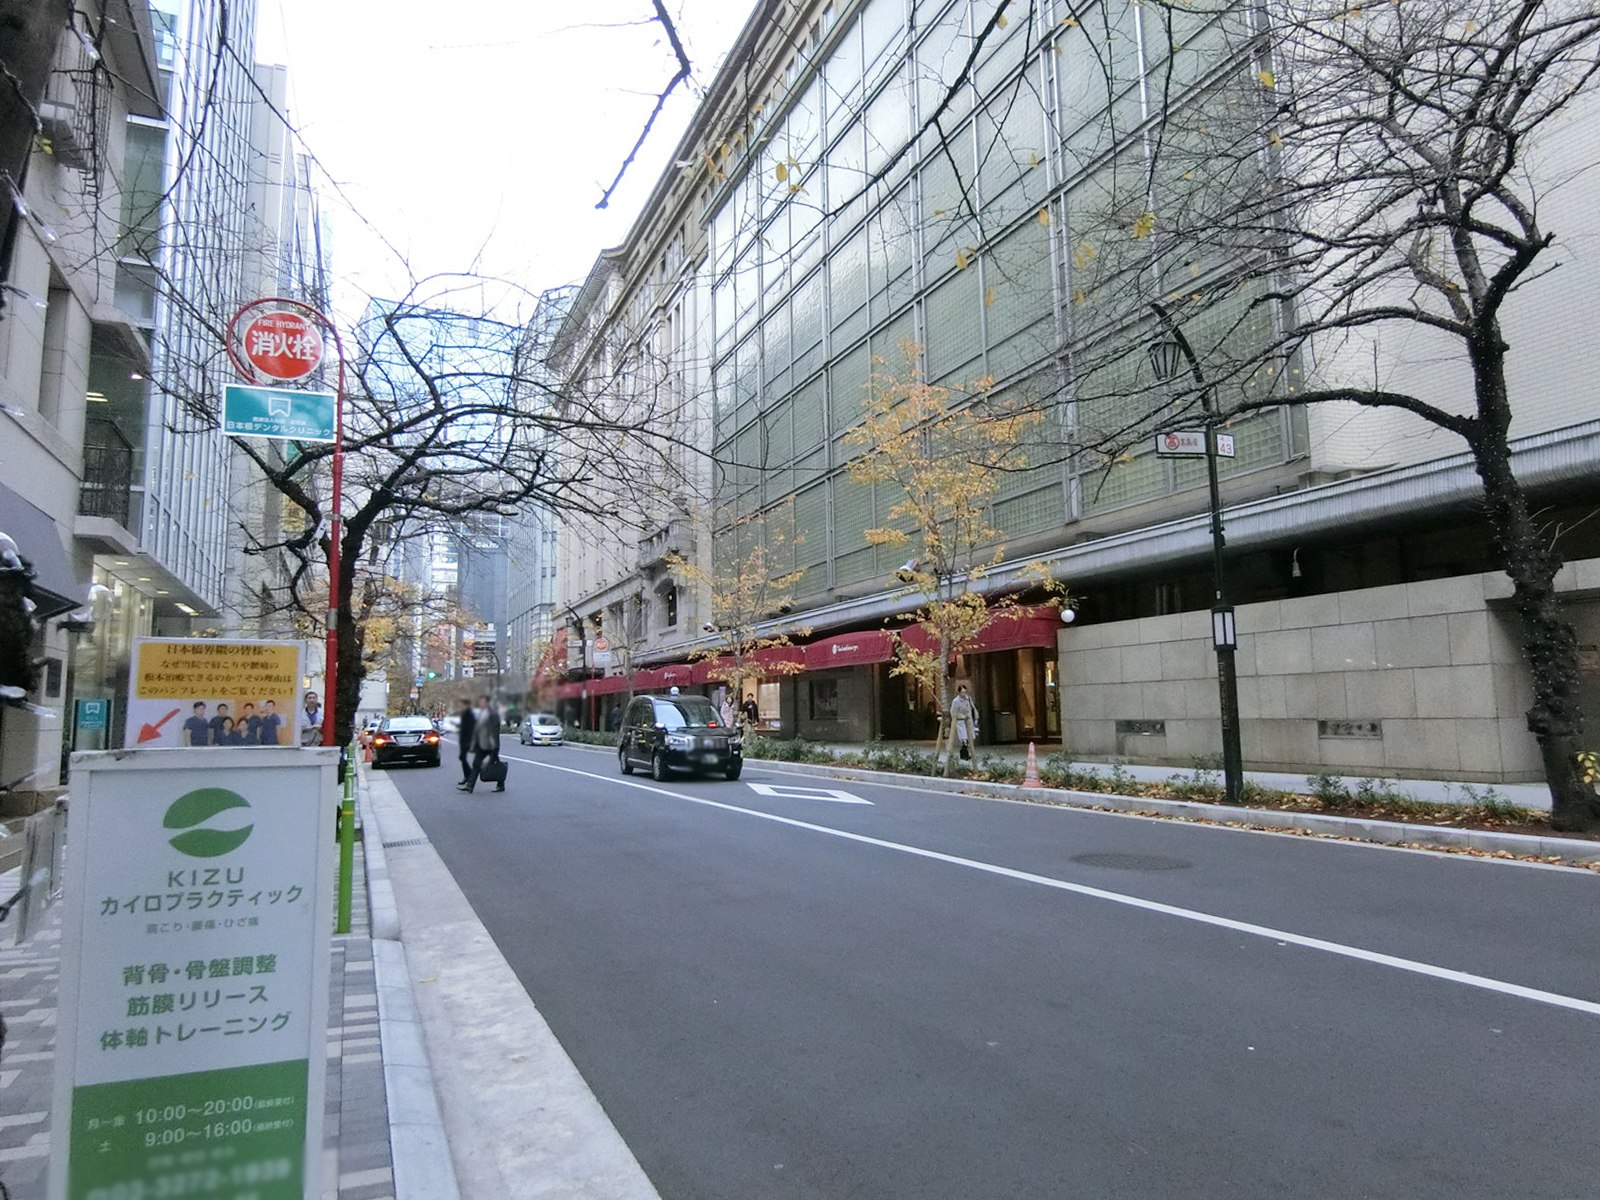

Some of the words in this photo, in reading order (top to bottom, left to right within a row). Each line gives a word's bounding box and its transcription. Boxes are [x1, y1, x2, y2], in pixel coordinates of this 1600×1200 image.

[258, 319, 274, 328] FIRE
[276, 320, 310, 330] HYDRANT
[251, 330, 317, 361] 消火栓
[226, 420, 331, 436] 日本橋デンタルクリニック
[1220, 443, 1232, 454] 43
[167, 644, 276, 656] 日本橋界隈の皆様へ
[161, 660, 279, 669] なぜ当院で肩こりや腰痛の
[168, 867, 244, 887] KIZU
[100, 885, 303, 916] カイロプラクティック
[123, 954, 277, 986] 背骨・骨盤調整
[126, 985, 268, 1017] 筋膜リリース
[100, 1011, 292, 1051] 体軸トレーニング
[98, 1140, 112, 1153] 土
